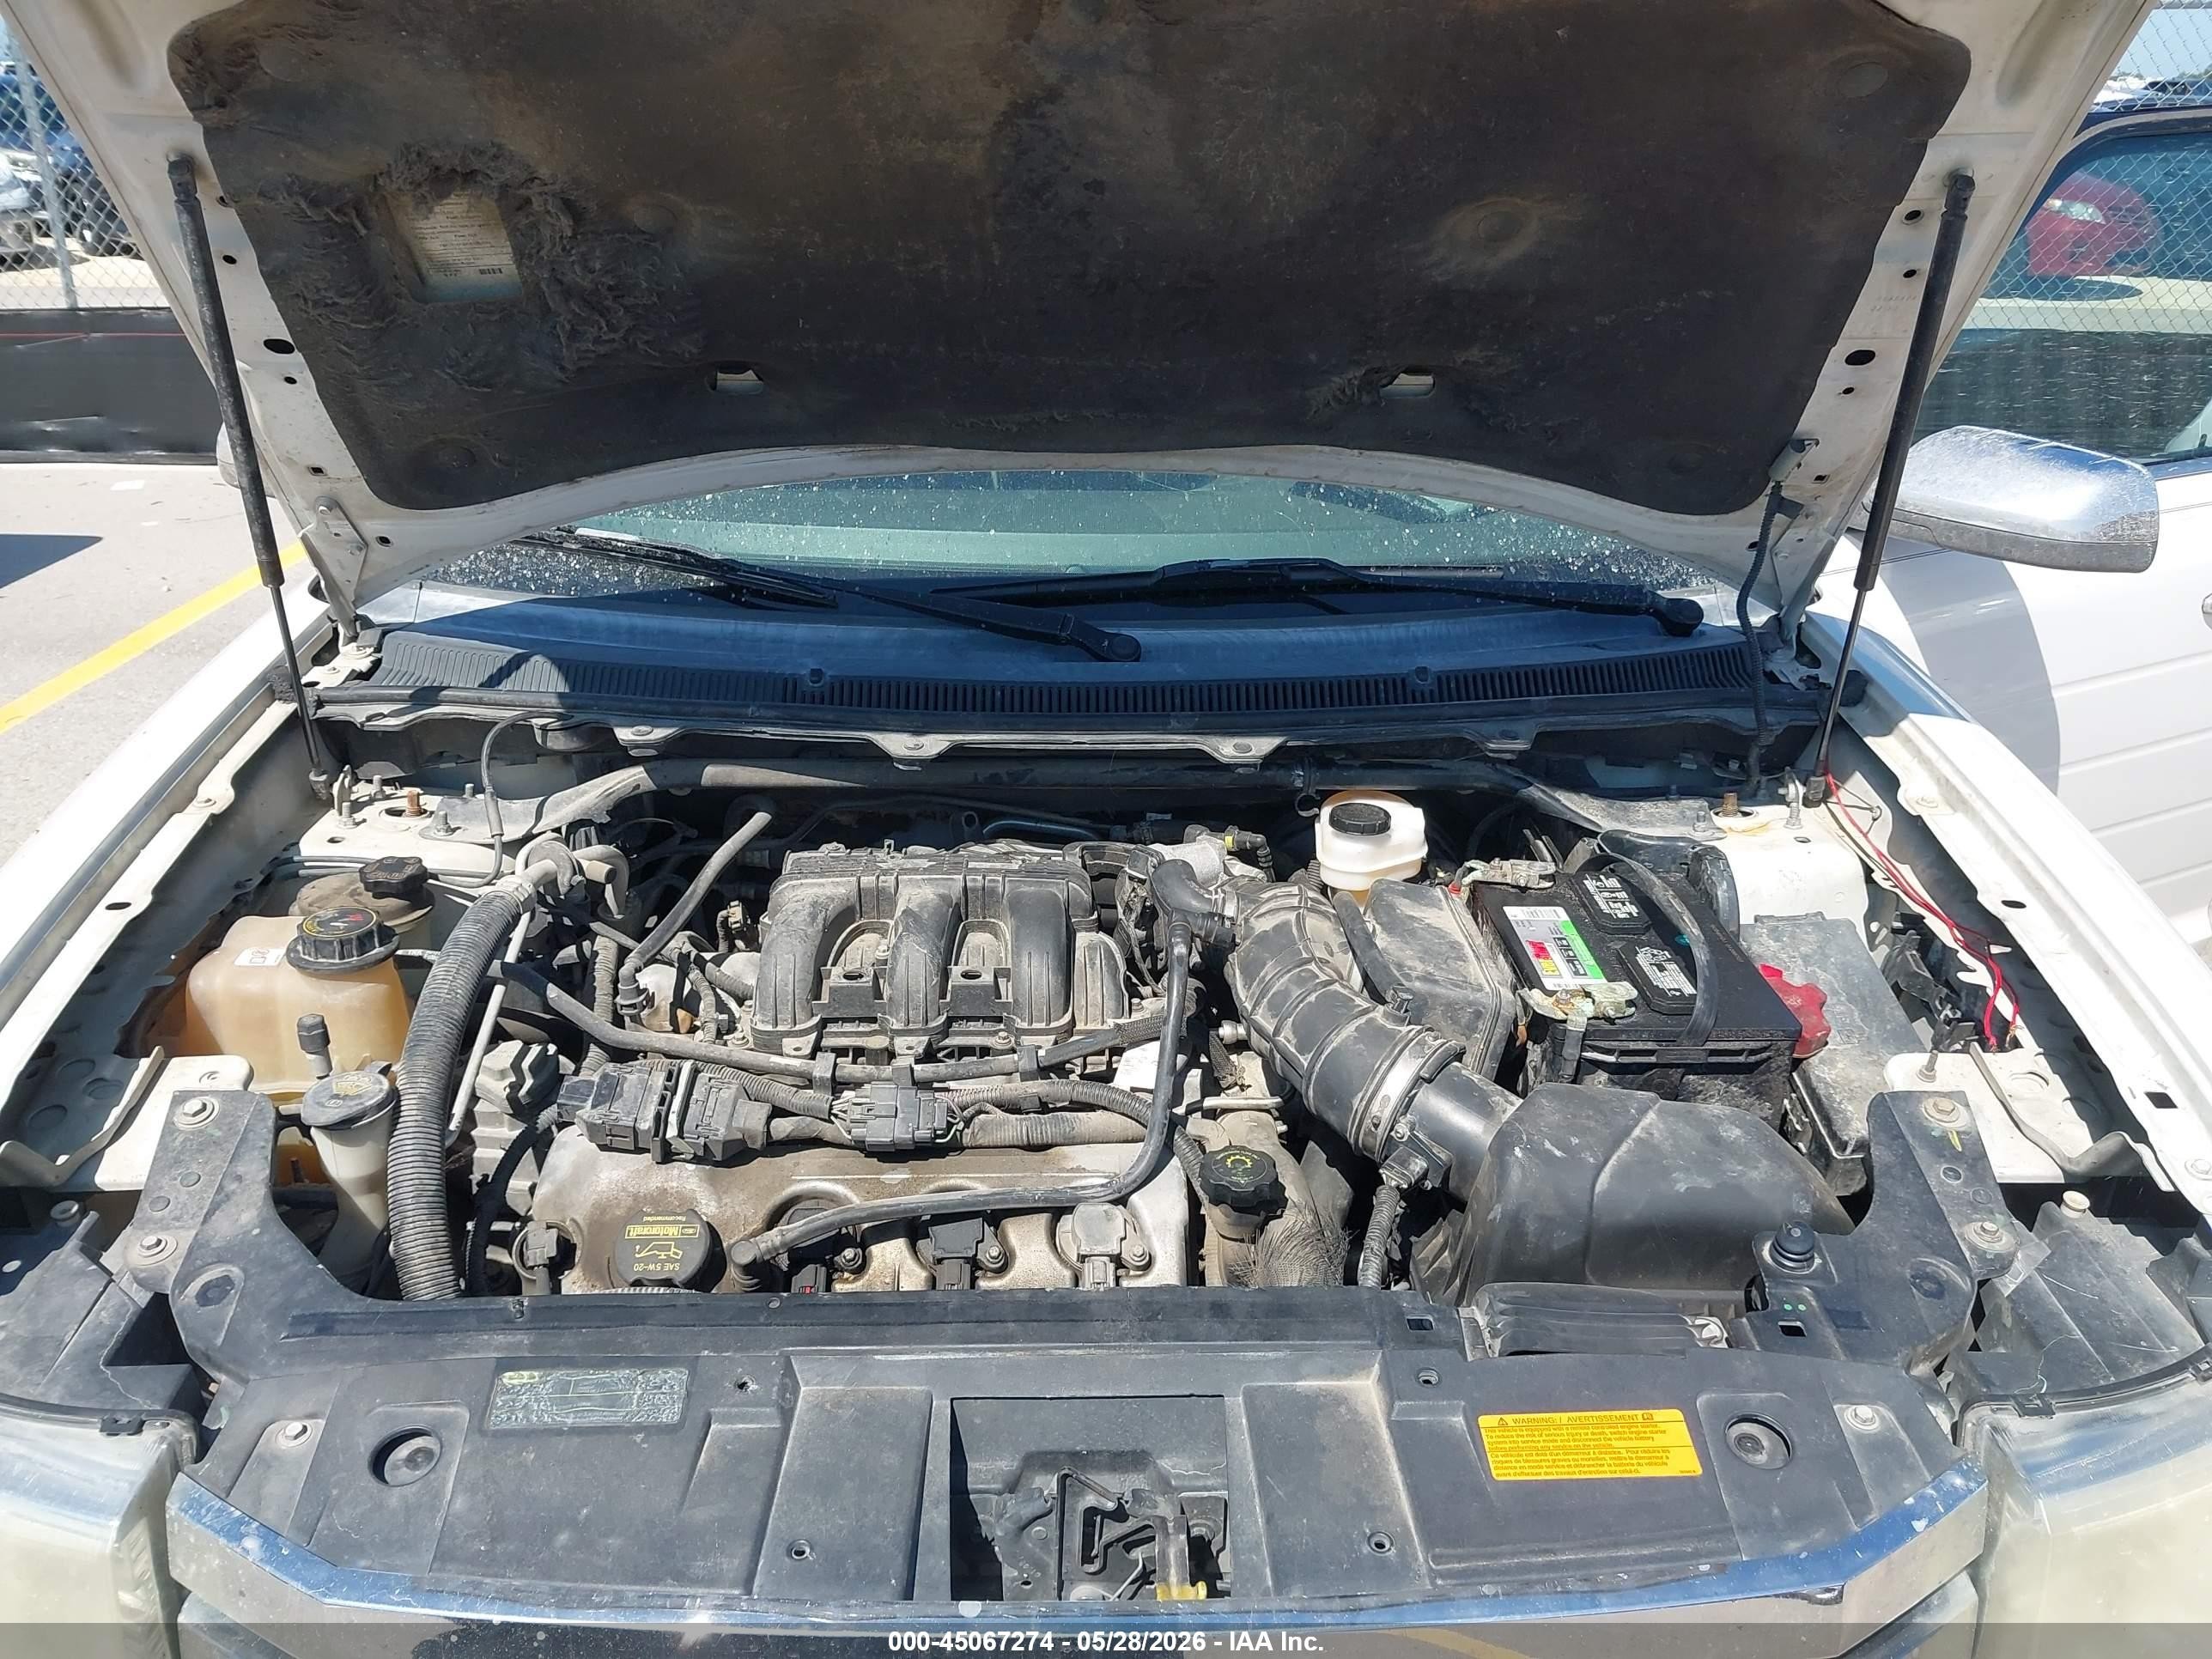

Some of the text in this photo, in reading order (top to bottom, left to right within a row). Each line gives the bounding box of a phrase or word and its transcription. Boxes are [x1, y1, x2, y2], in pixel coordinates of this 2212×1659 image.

[629, 1226, 679, 1237] Motorcraft
[634, 1262, 680, 1272] SAE 5W-20
[1566, 1414, 1640, 1424] AVERTISSEMENT
